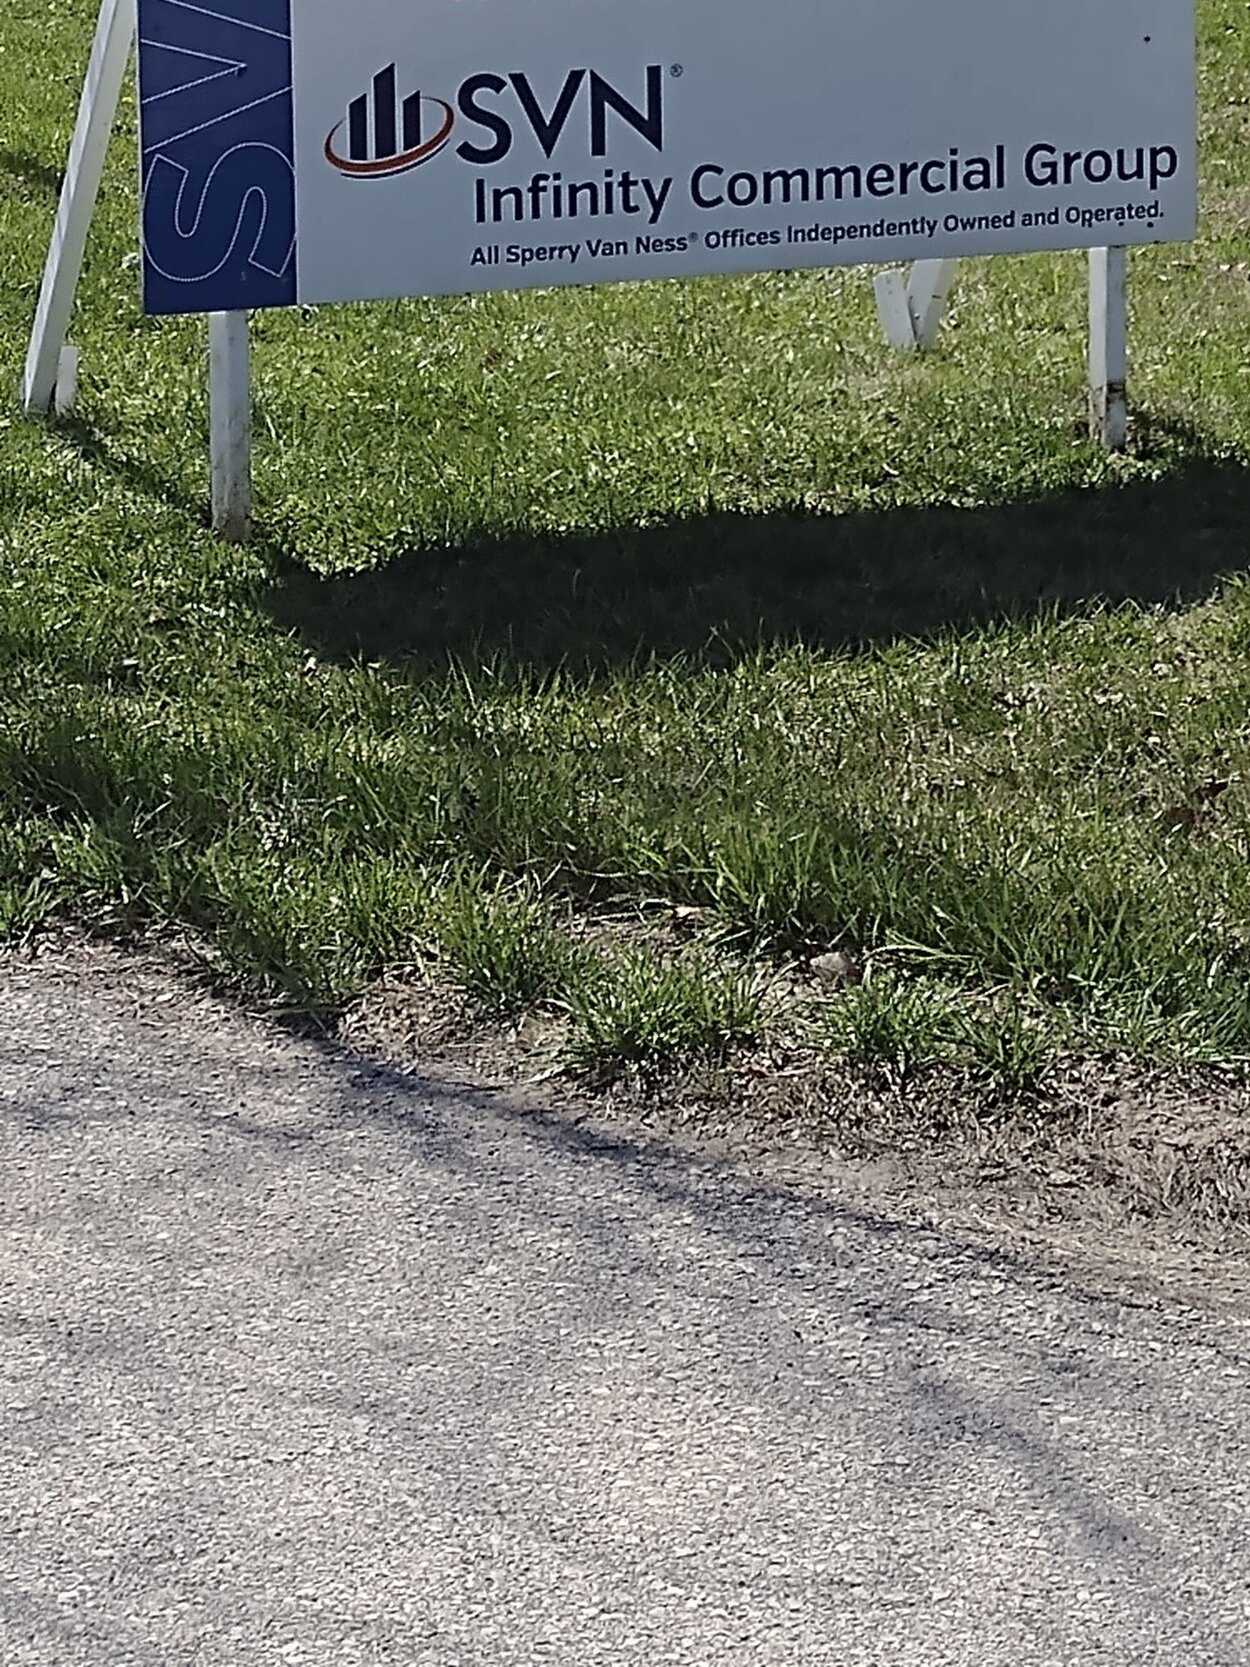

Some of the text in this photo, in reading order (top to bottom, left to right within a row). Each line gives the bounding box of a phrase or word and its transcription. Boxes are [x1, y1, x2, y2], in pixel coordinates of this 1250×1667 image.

[475, 142, 1178, 225] Infinity Commercial Group
[470, 244, 499, 266] All
[505, 243, 581, 268] Sperry
[585, 238, 629, 258] Van
[704, 227, 781, 250] Offices
[786, 218, 939, 245] Independently
[943, 210, 1016, 233] Owned
[1021, 206, 1060, 228] and
